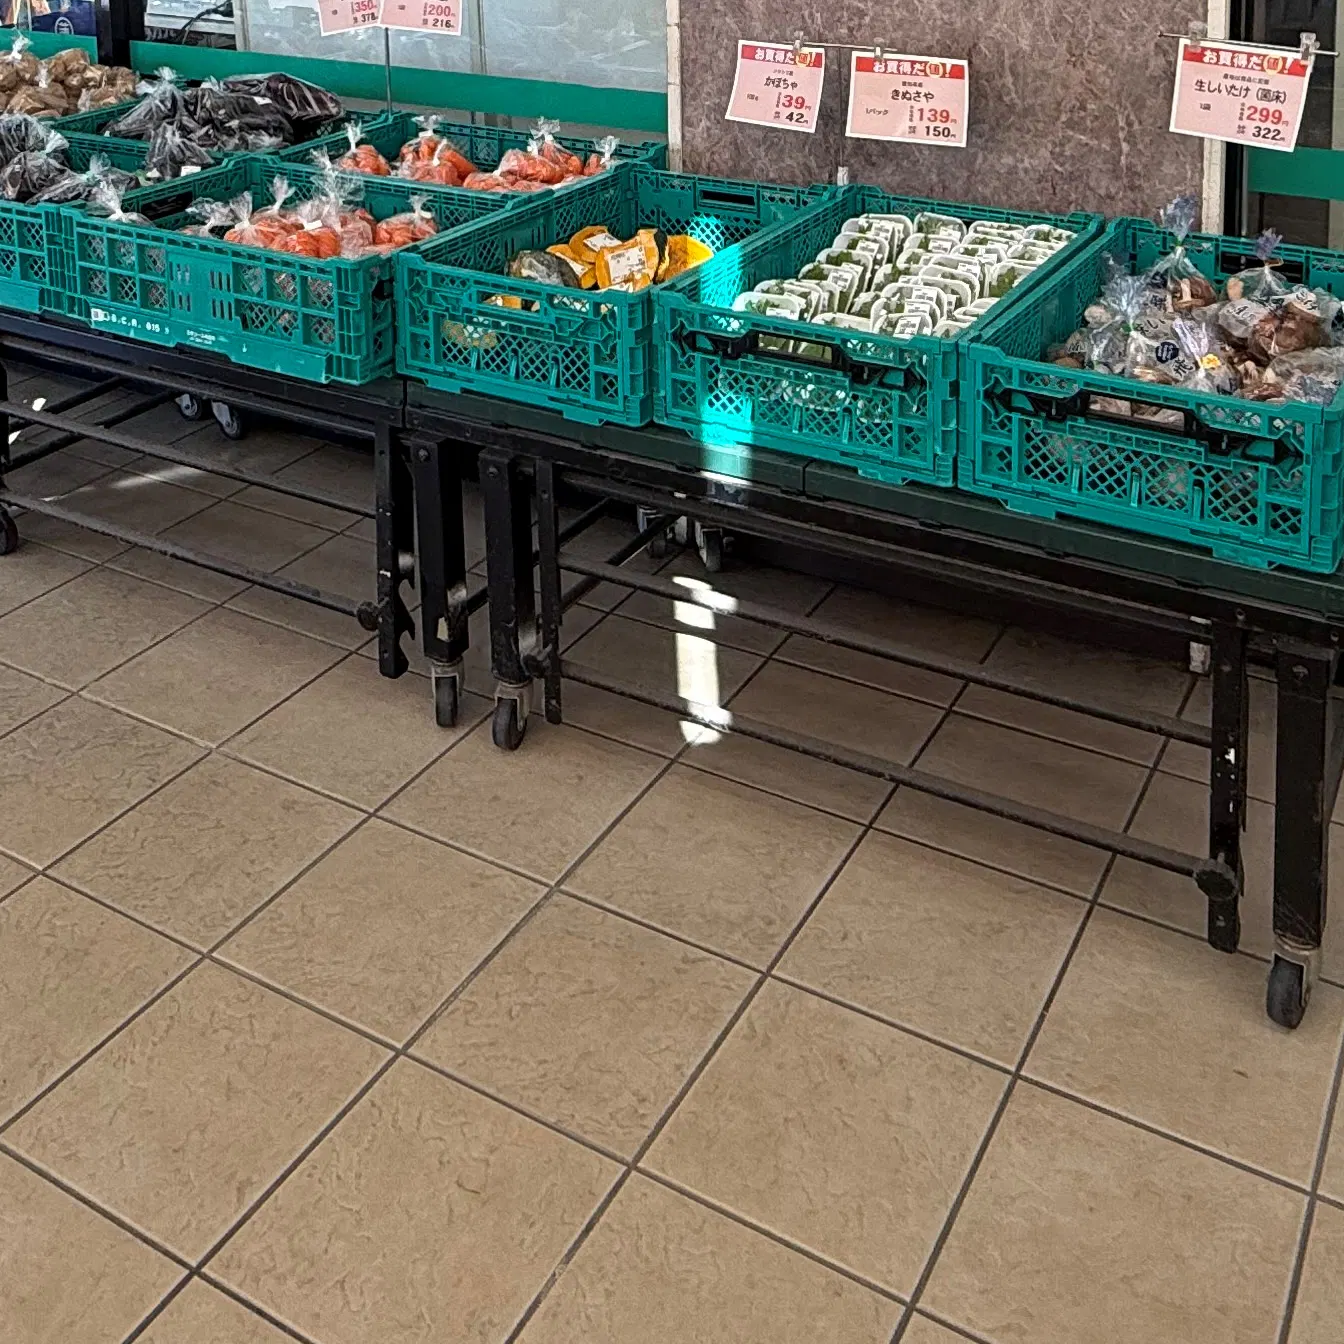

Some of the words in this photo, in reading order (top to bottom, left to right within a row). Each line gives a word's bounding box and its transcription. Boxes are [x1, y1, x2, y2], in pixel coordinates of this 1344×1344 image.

[764, 76, 798, 90] かぼちゃ
[891, 89, 934, 103] きぬさや
